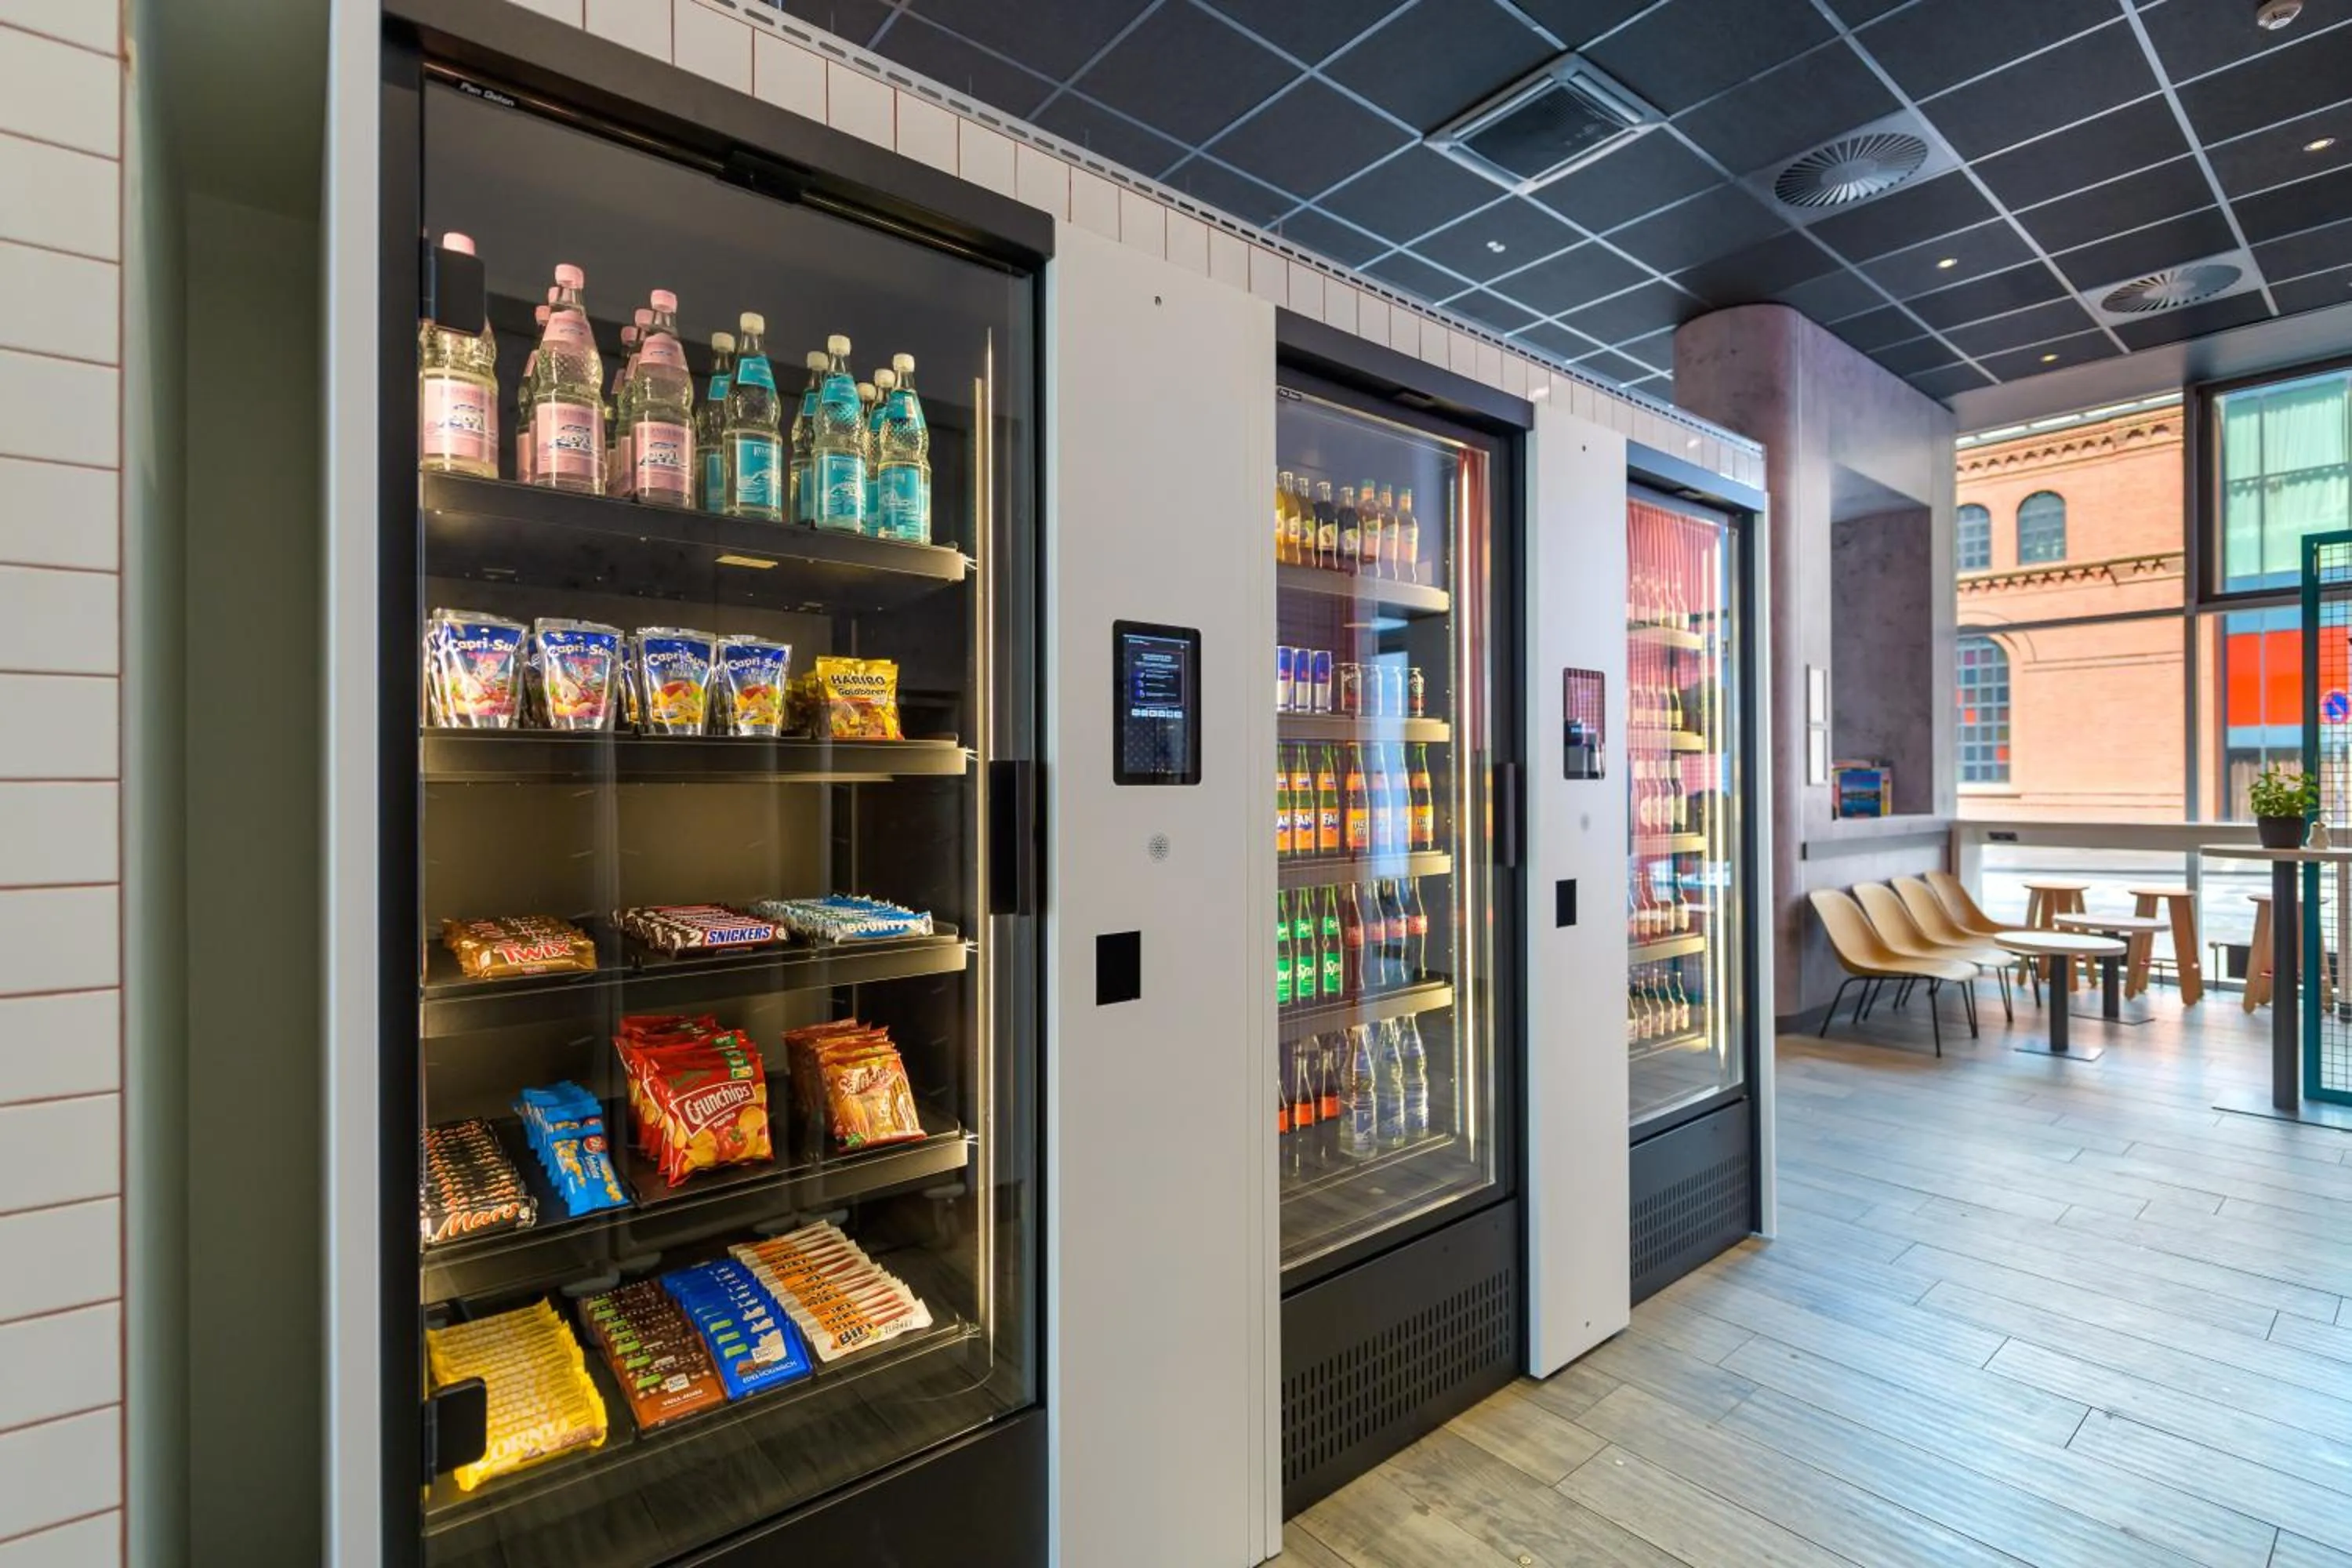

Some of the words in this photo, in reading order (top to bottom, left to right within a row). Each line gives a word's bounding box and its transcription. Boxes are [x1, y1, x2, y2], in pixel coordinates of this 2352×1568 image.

[831, 675, 885, 684] HARIBO
[709, 927, 771, 944] SNICKERS
[684, 1085, 750, 1125] Crunchips
[435, 1203, 520, 1241] Mars
